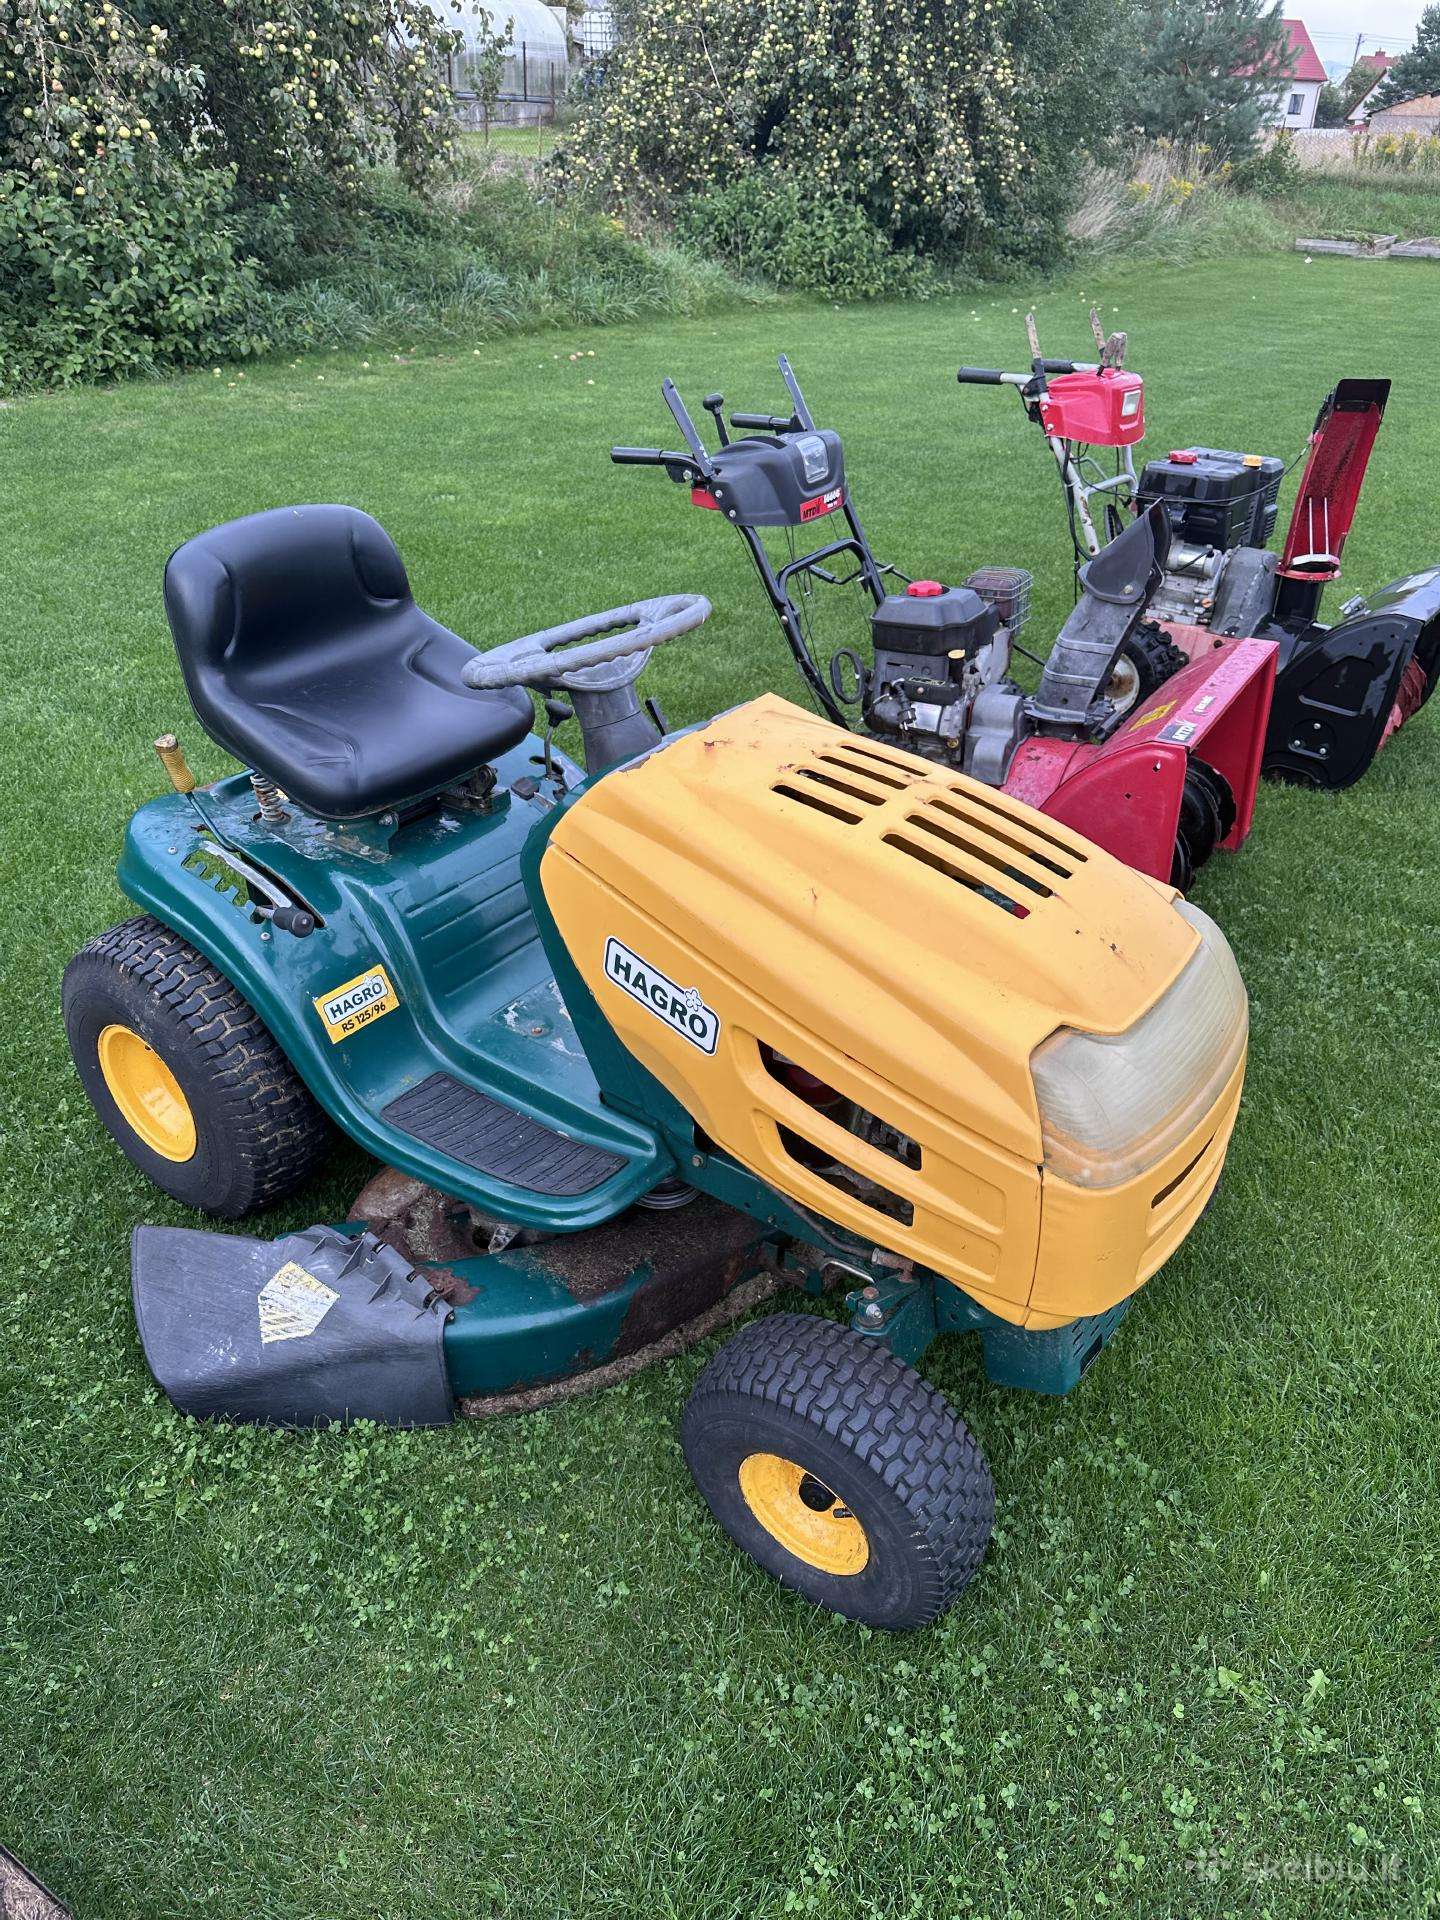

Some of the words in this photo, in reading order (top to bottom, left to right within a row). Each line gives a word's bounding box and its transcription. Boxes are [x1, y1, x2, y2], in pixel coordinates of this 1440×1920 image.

[330, 983, 383, 1018] HAGRO
[614, 953, 708, 1039] HAGRO
[342, 1020, 355, 1033] RS
[355, 1002, 386, 1024] 125/96
